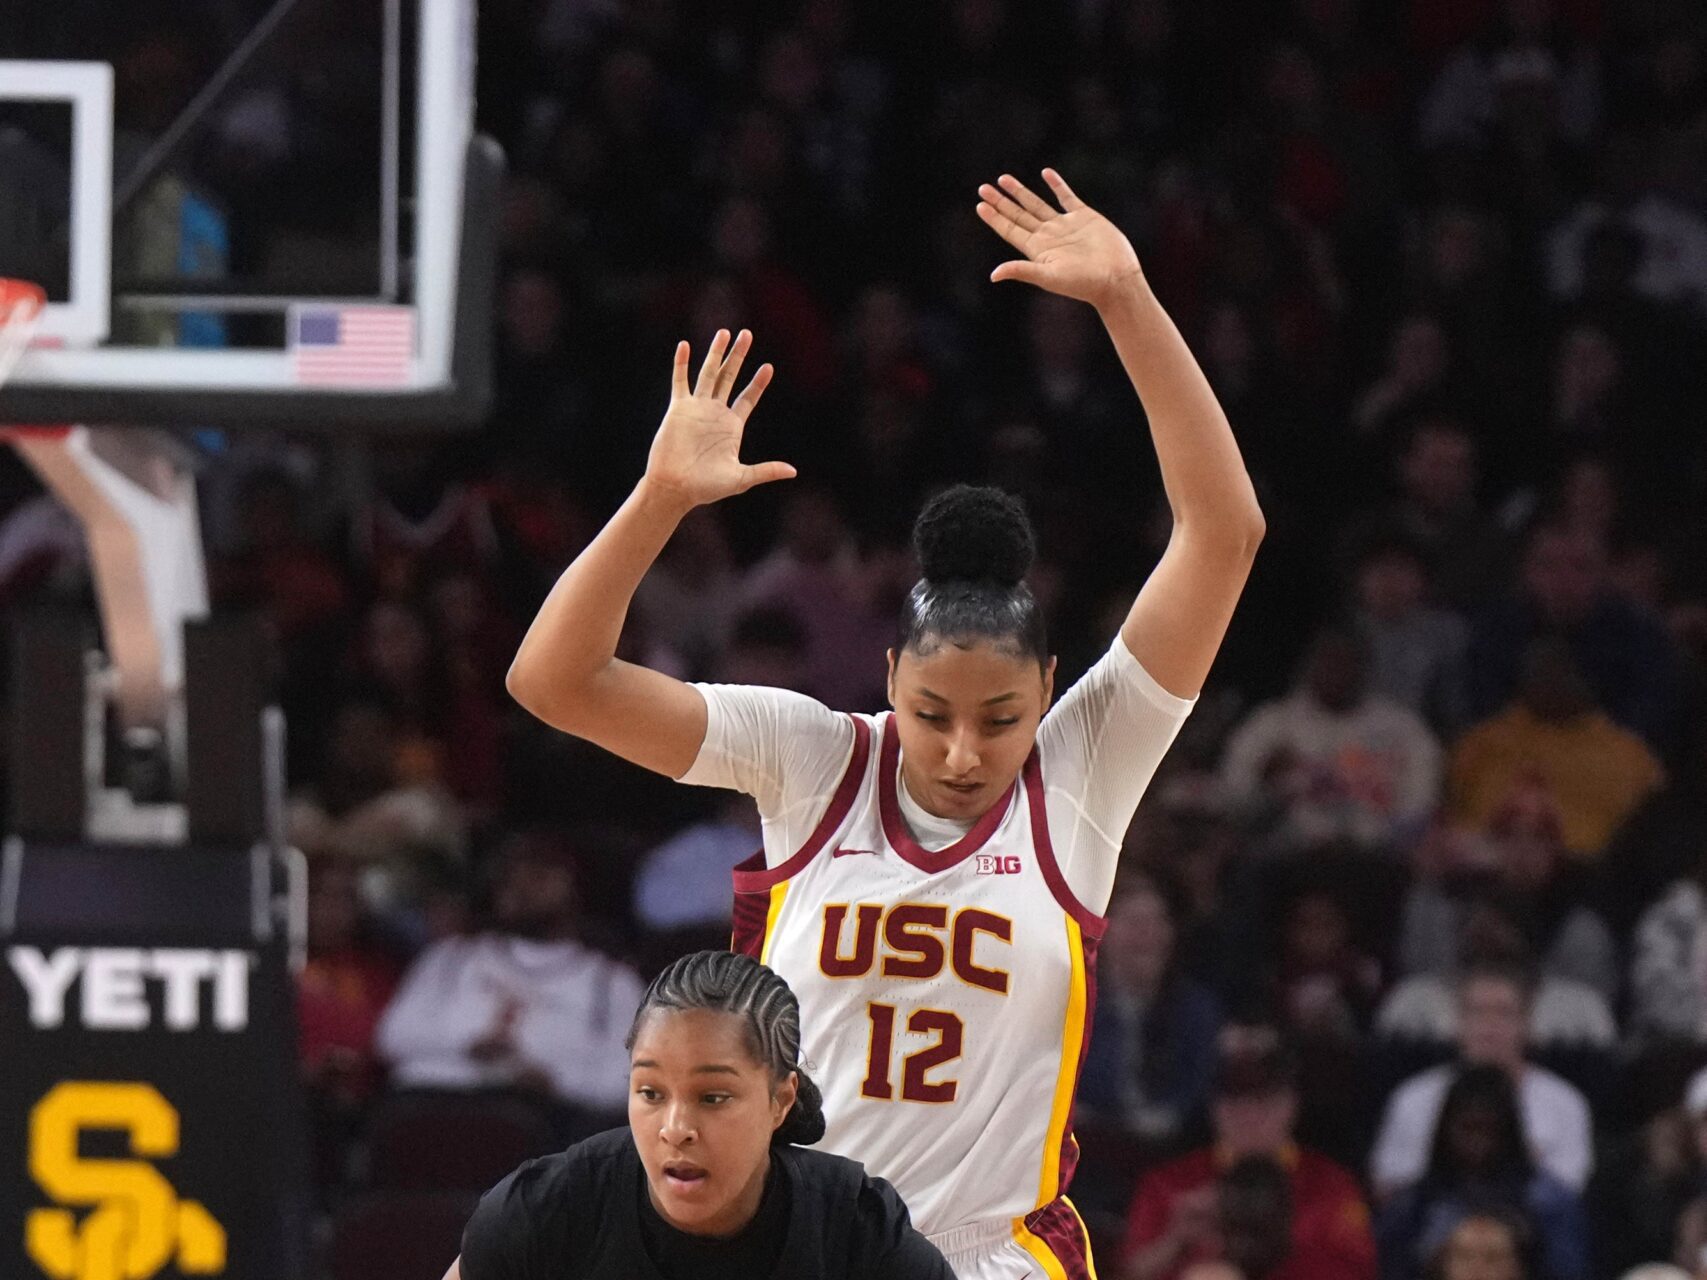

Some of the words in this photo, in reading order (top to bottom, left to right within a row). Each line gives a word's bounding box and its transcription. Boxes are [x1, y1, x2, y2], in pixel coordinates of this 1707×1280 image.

[8, 945, 250, 1031] YETI
[818, 903, 1013, 997] USC
[861, 1001, 964, 1105] 12
